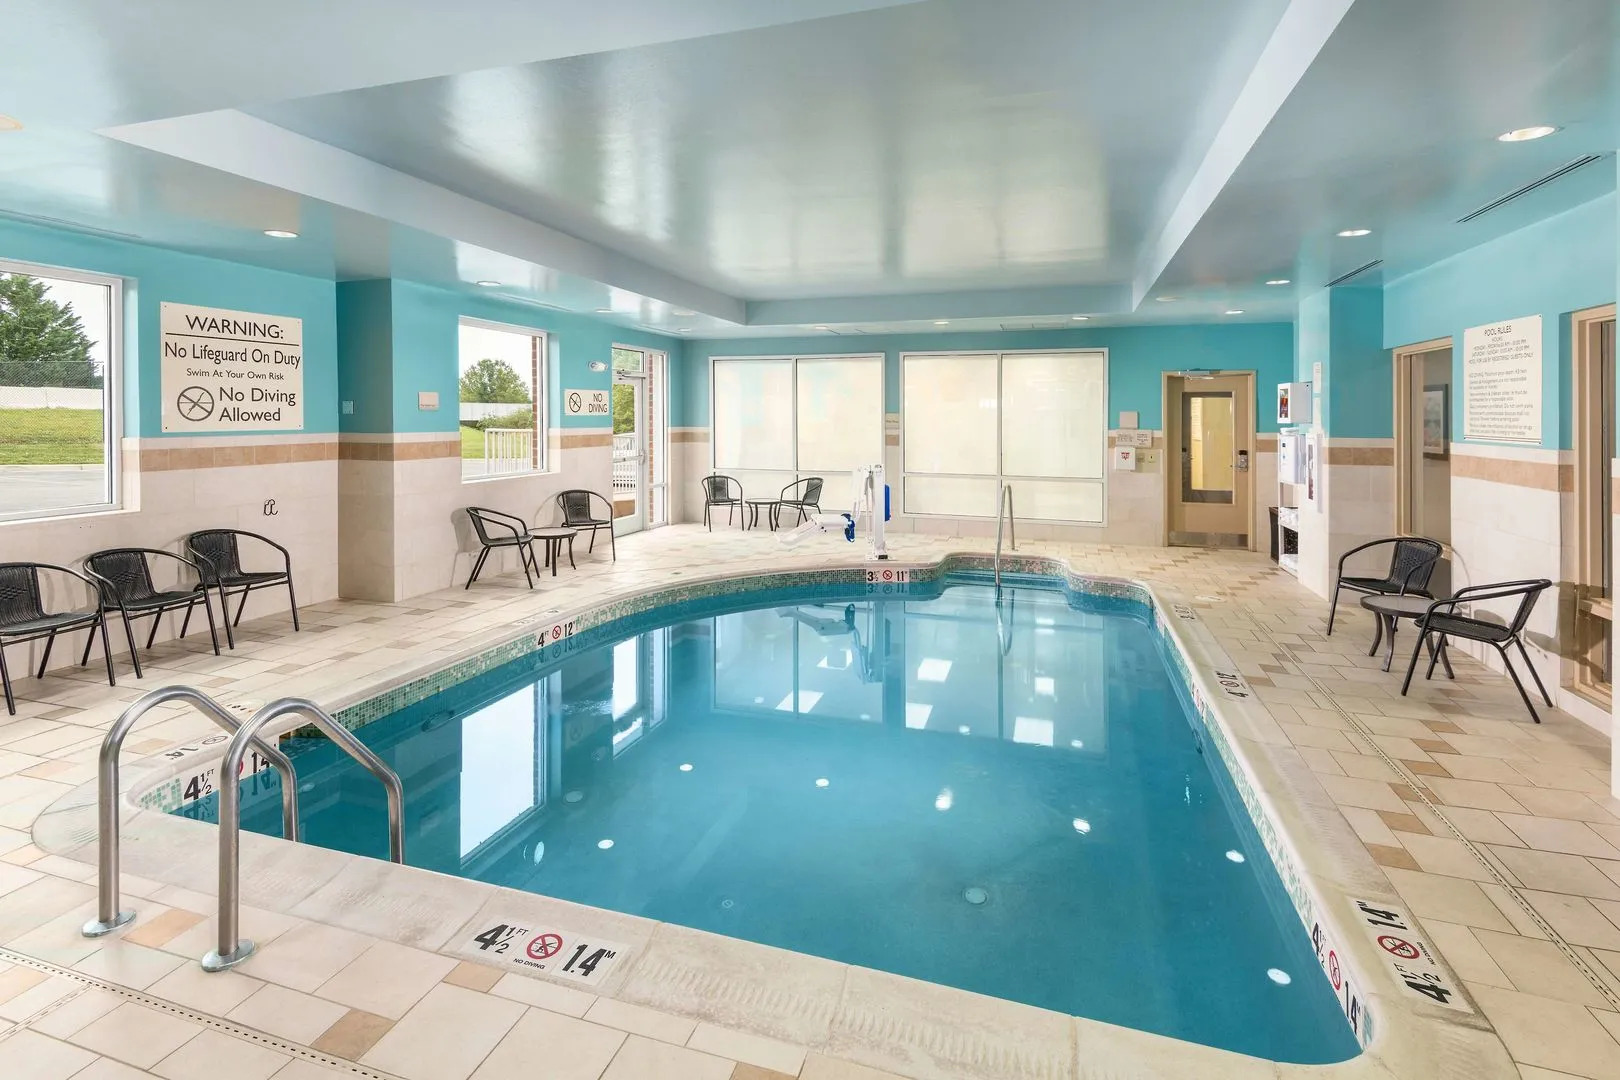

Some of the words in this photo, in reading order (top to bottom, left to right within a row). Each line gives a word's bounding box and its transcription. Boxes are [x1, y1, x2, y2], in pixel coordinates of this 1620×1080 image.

[185, 314, 284, 339] WARNING:
[1484, 328, 1497, 337] POOL
[1497, 325, 1512, 334] RULES
[165, 342, 187, 358] No
[192, 344, 247, 364] Lifeguard
[251, 349, 270, 364] On
[274, 350, 301, 369] Duty
[186, 368, 210, 377] Swim
[212, 369, 223, 378] At
[225, 370, 245, 379] Your
[247, 371, 267, 379] Own
[269, 372, 284, 381] Risk
[219, 387, 245, 402] No
[251, 388, 296, 406] Diving
[593, 393, 602, 402] NO
[219, 407, 281, 422] Allowed
[588, 404, 608, 413] DIVING
[537, 632, 545, 647] 4
[516, 928, 529, 936] FT
[562, 944, 607, 977] 1.4
[604, 950, 617, 959] M
[524, 961, 545, 970] DIVING
